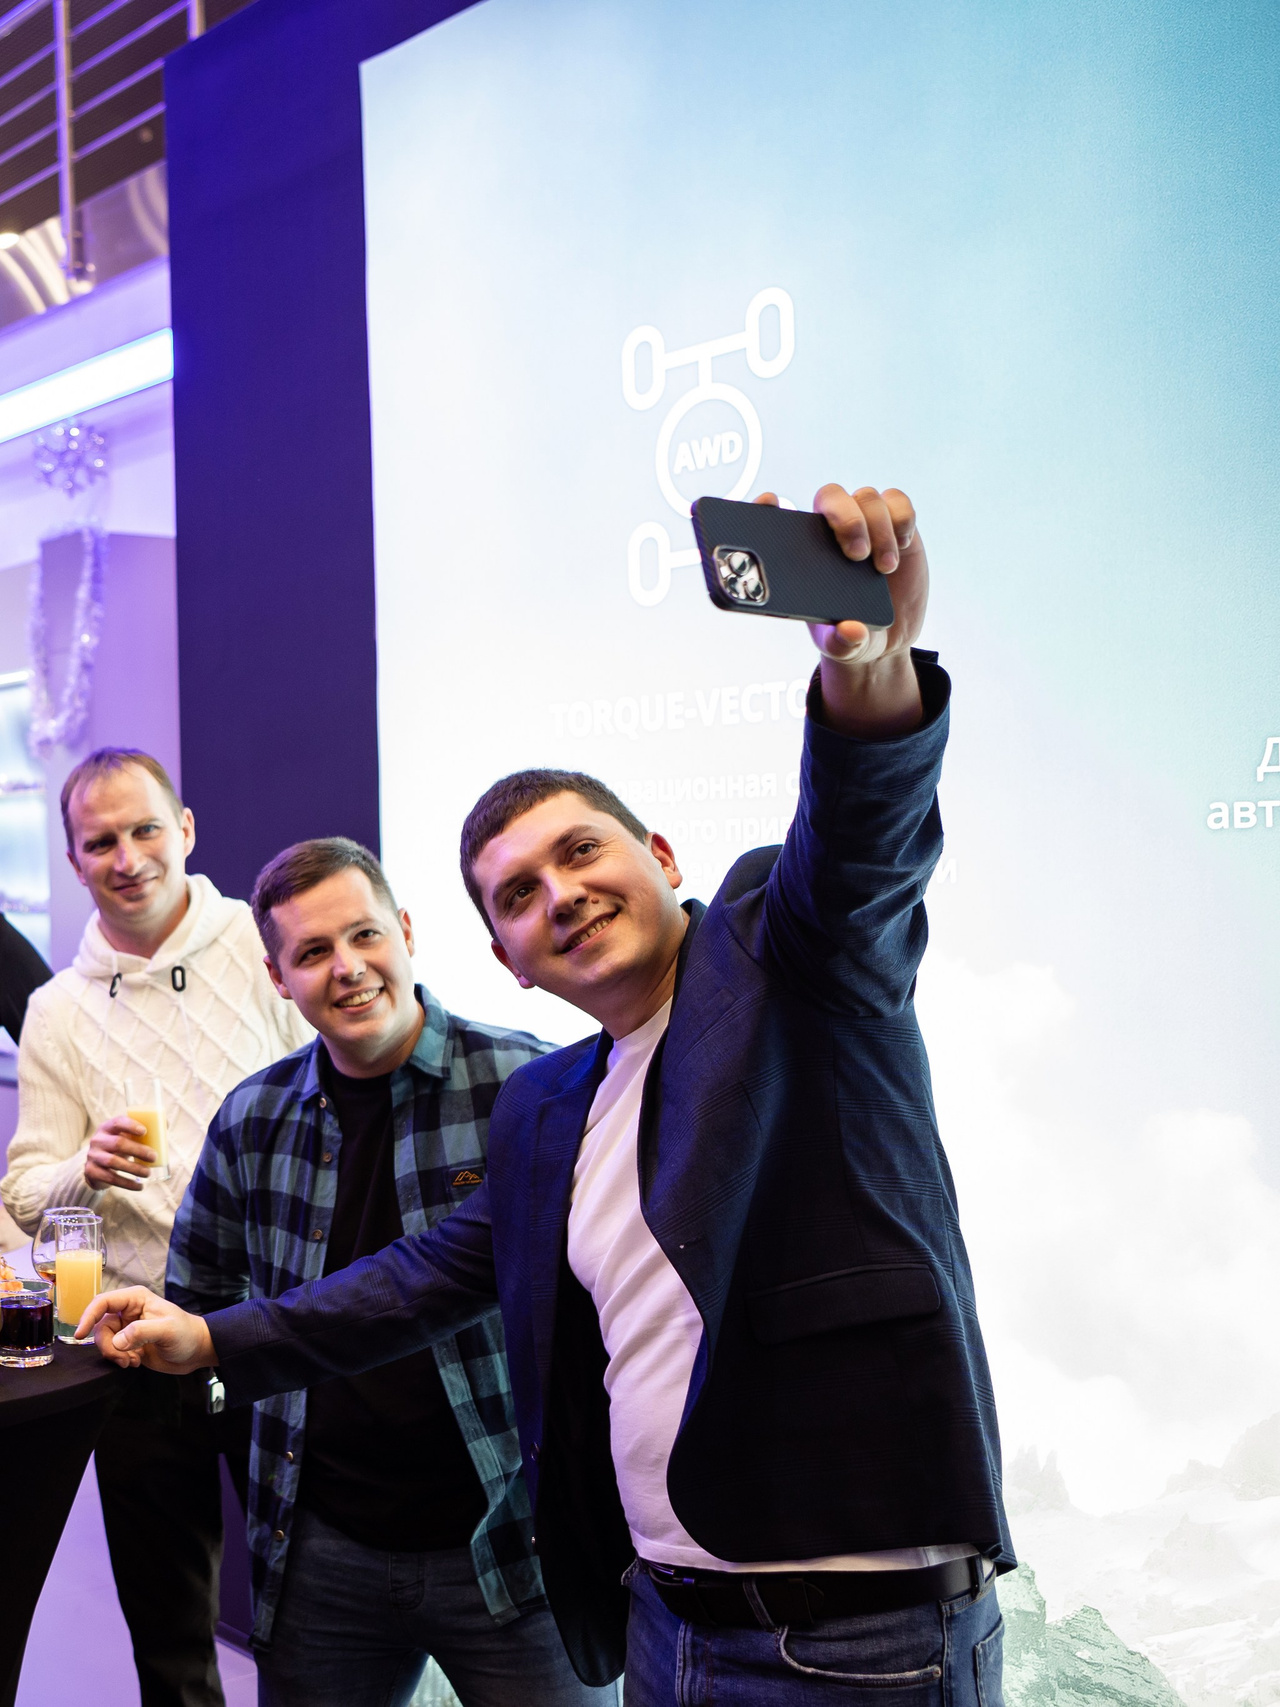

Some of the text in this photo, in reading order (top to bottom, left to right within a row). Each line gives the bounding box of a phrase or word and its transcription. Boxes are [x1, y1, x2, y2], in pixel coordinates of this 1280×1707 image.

[673, 431, 743, 475] AWD
[548, 679, 809, 740] TORQUE-VECTO
[1257, 736, 1280, 782] Д
[613, 771, 777, 809] овационная
[656, 818, 717, 844] ного
[1207, 799, 1280, 830] авт
